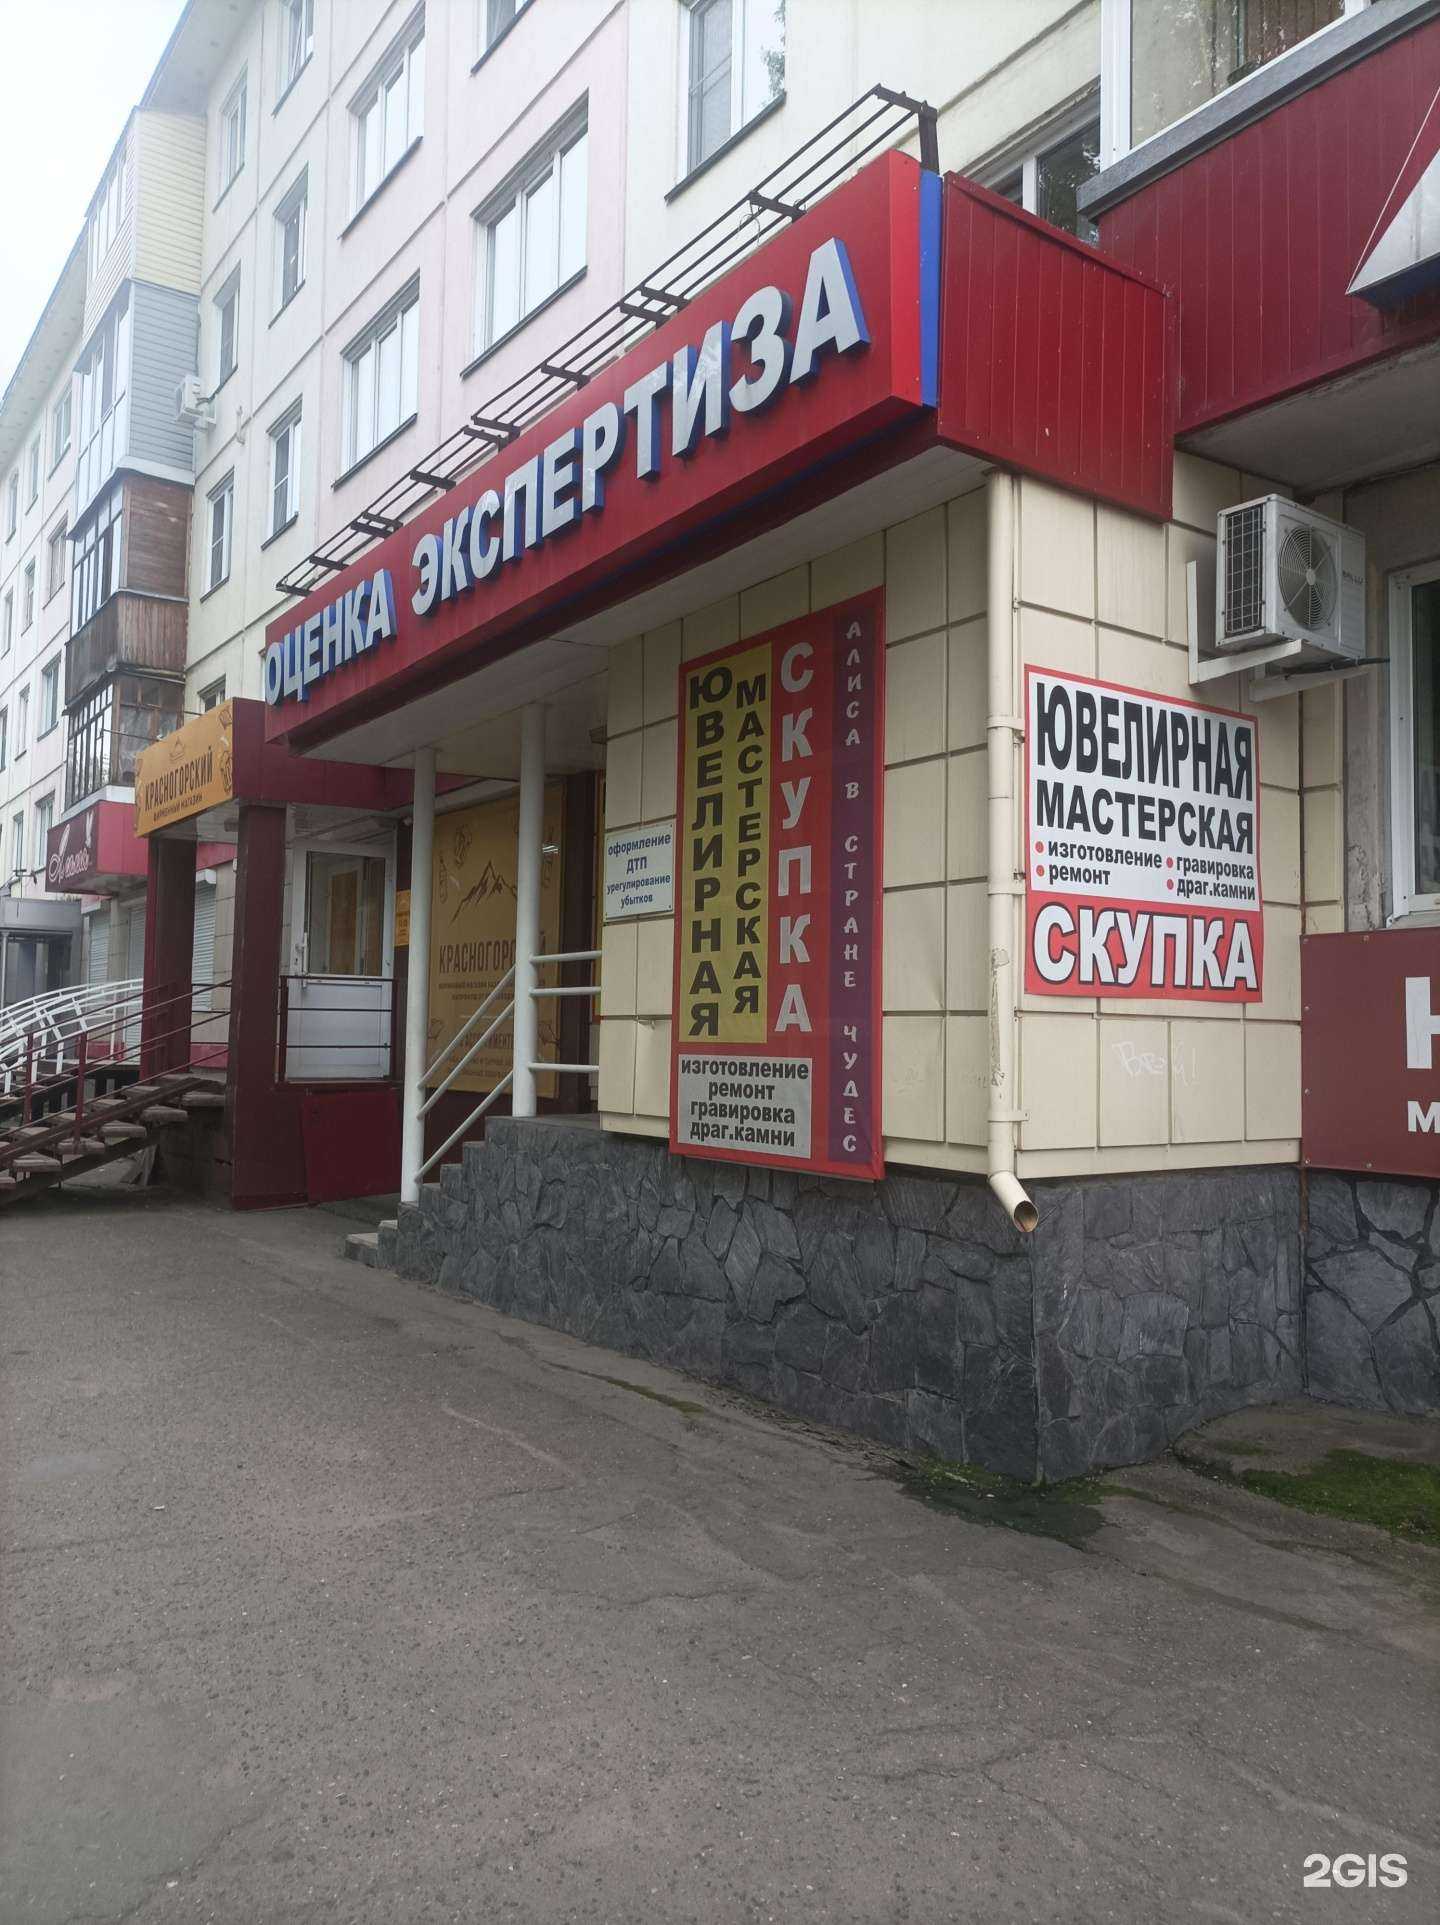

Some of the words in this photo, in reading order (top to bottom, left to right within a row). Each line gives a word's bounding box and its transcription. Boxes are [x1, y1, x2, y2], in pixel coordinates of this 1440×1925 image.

[265, 568, 397, 706] ОЦЕНКА
[411, 237, 870, 616] ЭКСПЕРТИЗА
[846, 620, 862, 746] АЛИСА
[1036, 682, 1253, 801] ЮВЕЛИРНАЯ
[144, 746, 213, 811] КРАСНОГОРСКИЙ
[846, 782, 860, 799] В
[1036, 779, 1254, 855] МАСТЕРСКАЯ
[608, 834, 671, 857] оформление
[733, 673, 766, 1014] МАСТЕРСКАЯ
[774, 641, 815, 1032] СКУПКА
[689, 666, 733, 1036] ЮВЕЛИРНАЯ
[1048, 841, 1162, 868] изготовление
[627, 856, 648, 875] ДТП
[1049, 864, 1111, 885] ремонт
[1176, 856, 1254, 880] гравировка
[607, 874, 671, 895] урегулирование
[1176, 878, 1256, 900] драг.камни
[621, 894, 653, 909] убытков
[844, 835, 860, 987] СТРАНЕ
[1033, 902, 1258, 992] СКУПКА
[681, 1059, 809, 1079] изготовление
[708, 1081, 775, 1100] ремонт
[842, 1024, 859, 1153] ЧУДЕС
[690, 1101, 795, 1124] гравировка
[690, 1121, 795, 1147] драг.камни
